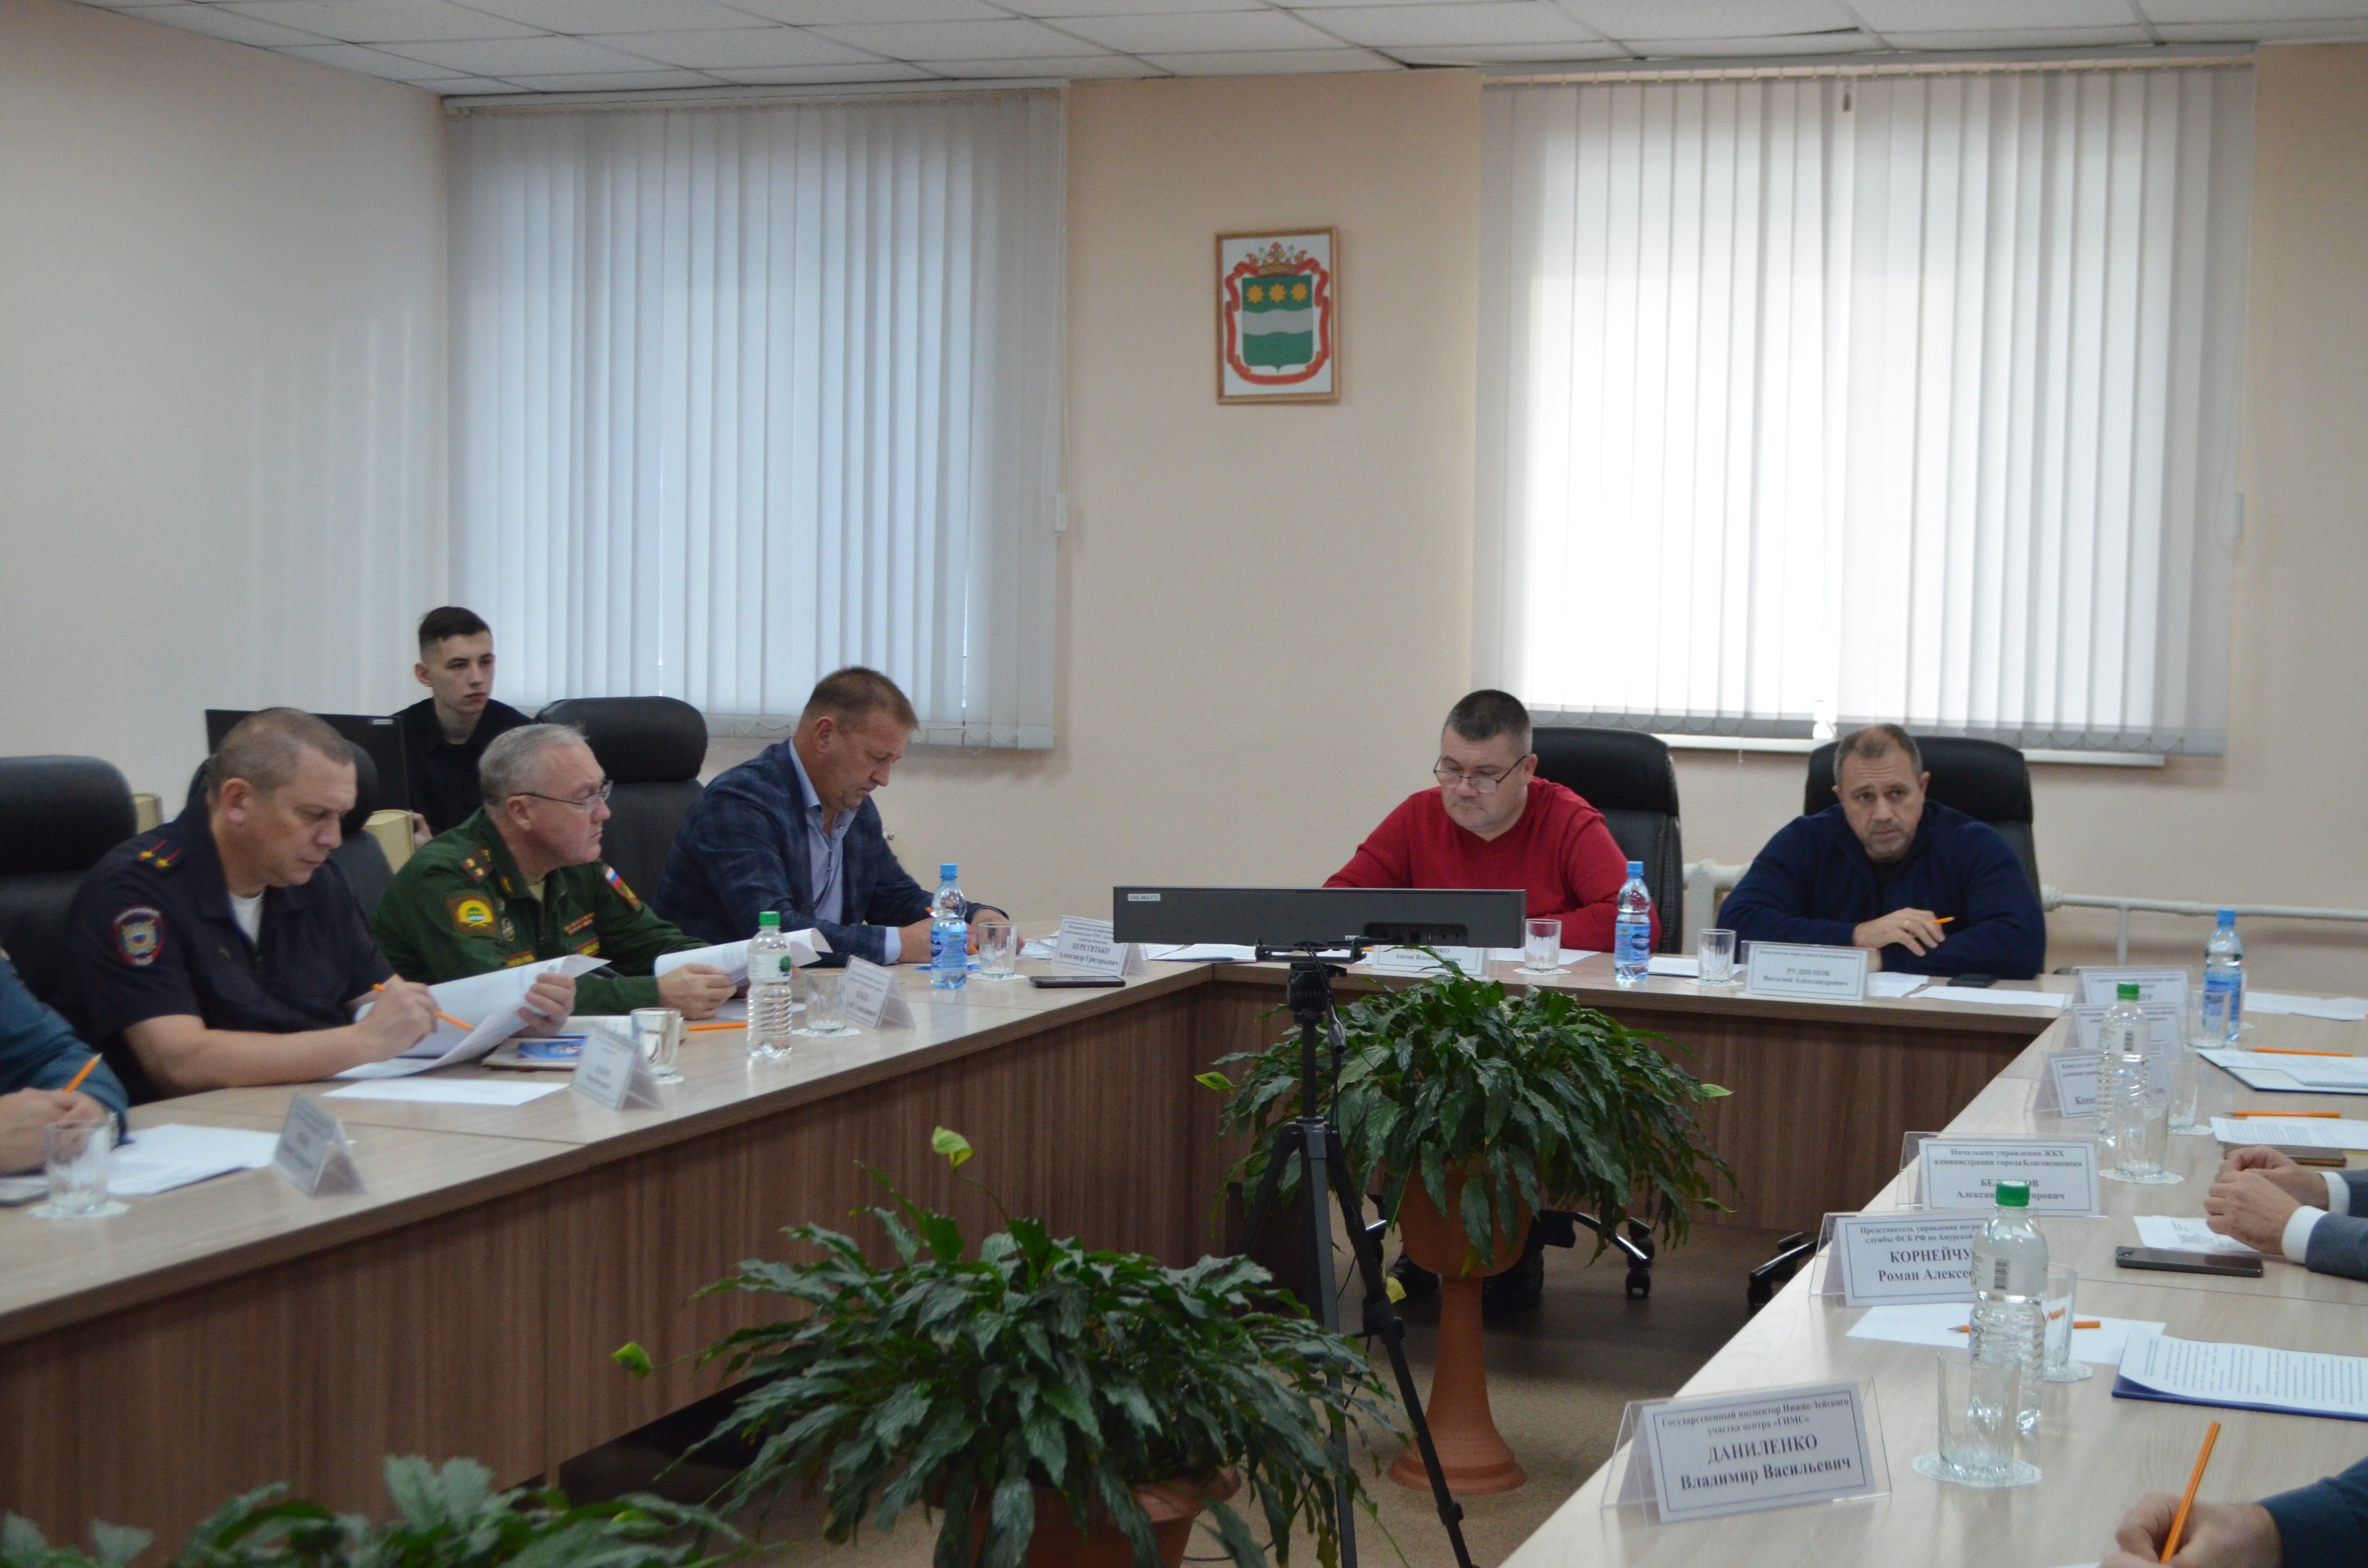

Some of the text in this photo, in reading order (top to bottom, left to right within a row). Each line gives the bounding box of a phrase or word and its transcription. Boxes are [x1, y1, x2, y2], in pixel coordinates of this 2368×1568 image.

[1072, 943, 1110, 955] ПЕРЕТЯТЬКО
[1059, 952, 1119, 967] Александр Григорьевич
[1795, 977, 1848, 986] Александрович
[2023, 1159, 2082, 1167] Благовещенска
[1865, 1237, 1894, 1245] службы
[1938, 1233, 1973, 1241] Амурской
[1890, 1247, 1972, 1263] КОРНЕЙЧУ
[1878, 1270, 1919, 1282] Роман
[1662, 1398, 1850, 1427] Государственный инспектор Нижне-Зейского
[1707, 1414, 1810, 1436] участка центра «ГИМС»
[1708, 1434, 1818, 1465] ДАНИЛЕНКО
[1681, 1457, 1851, 1490] Владимир Васильевич
